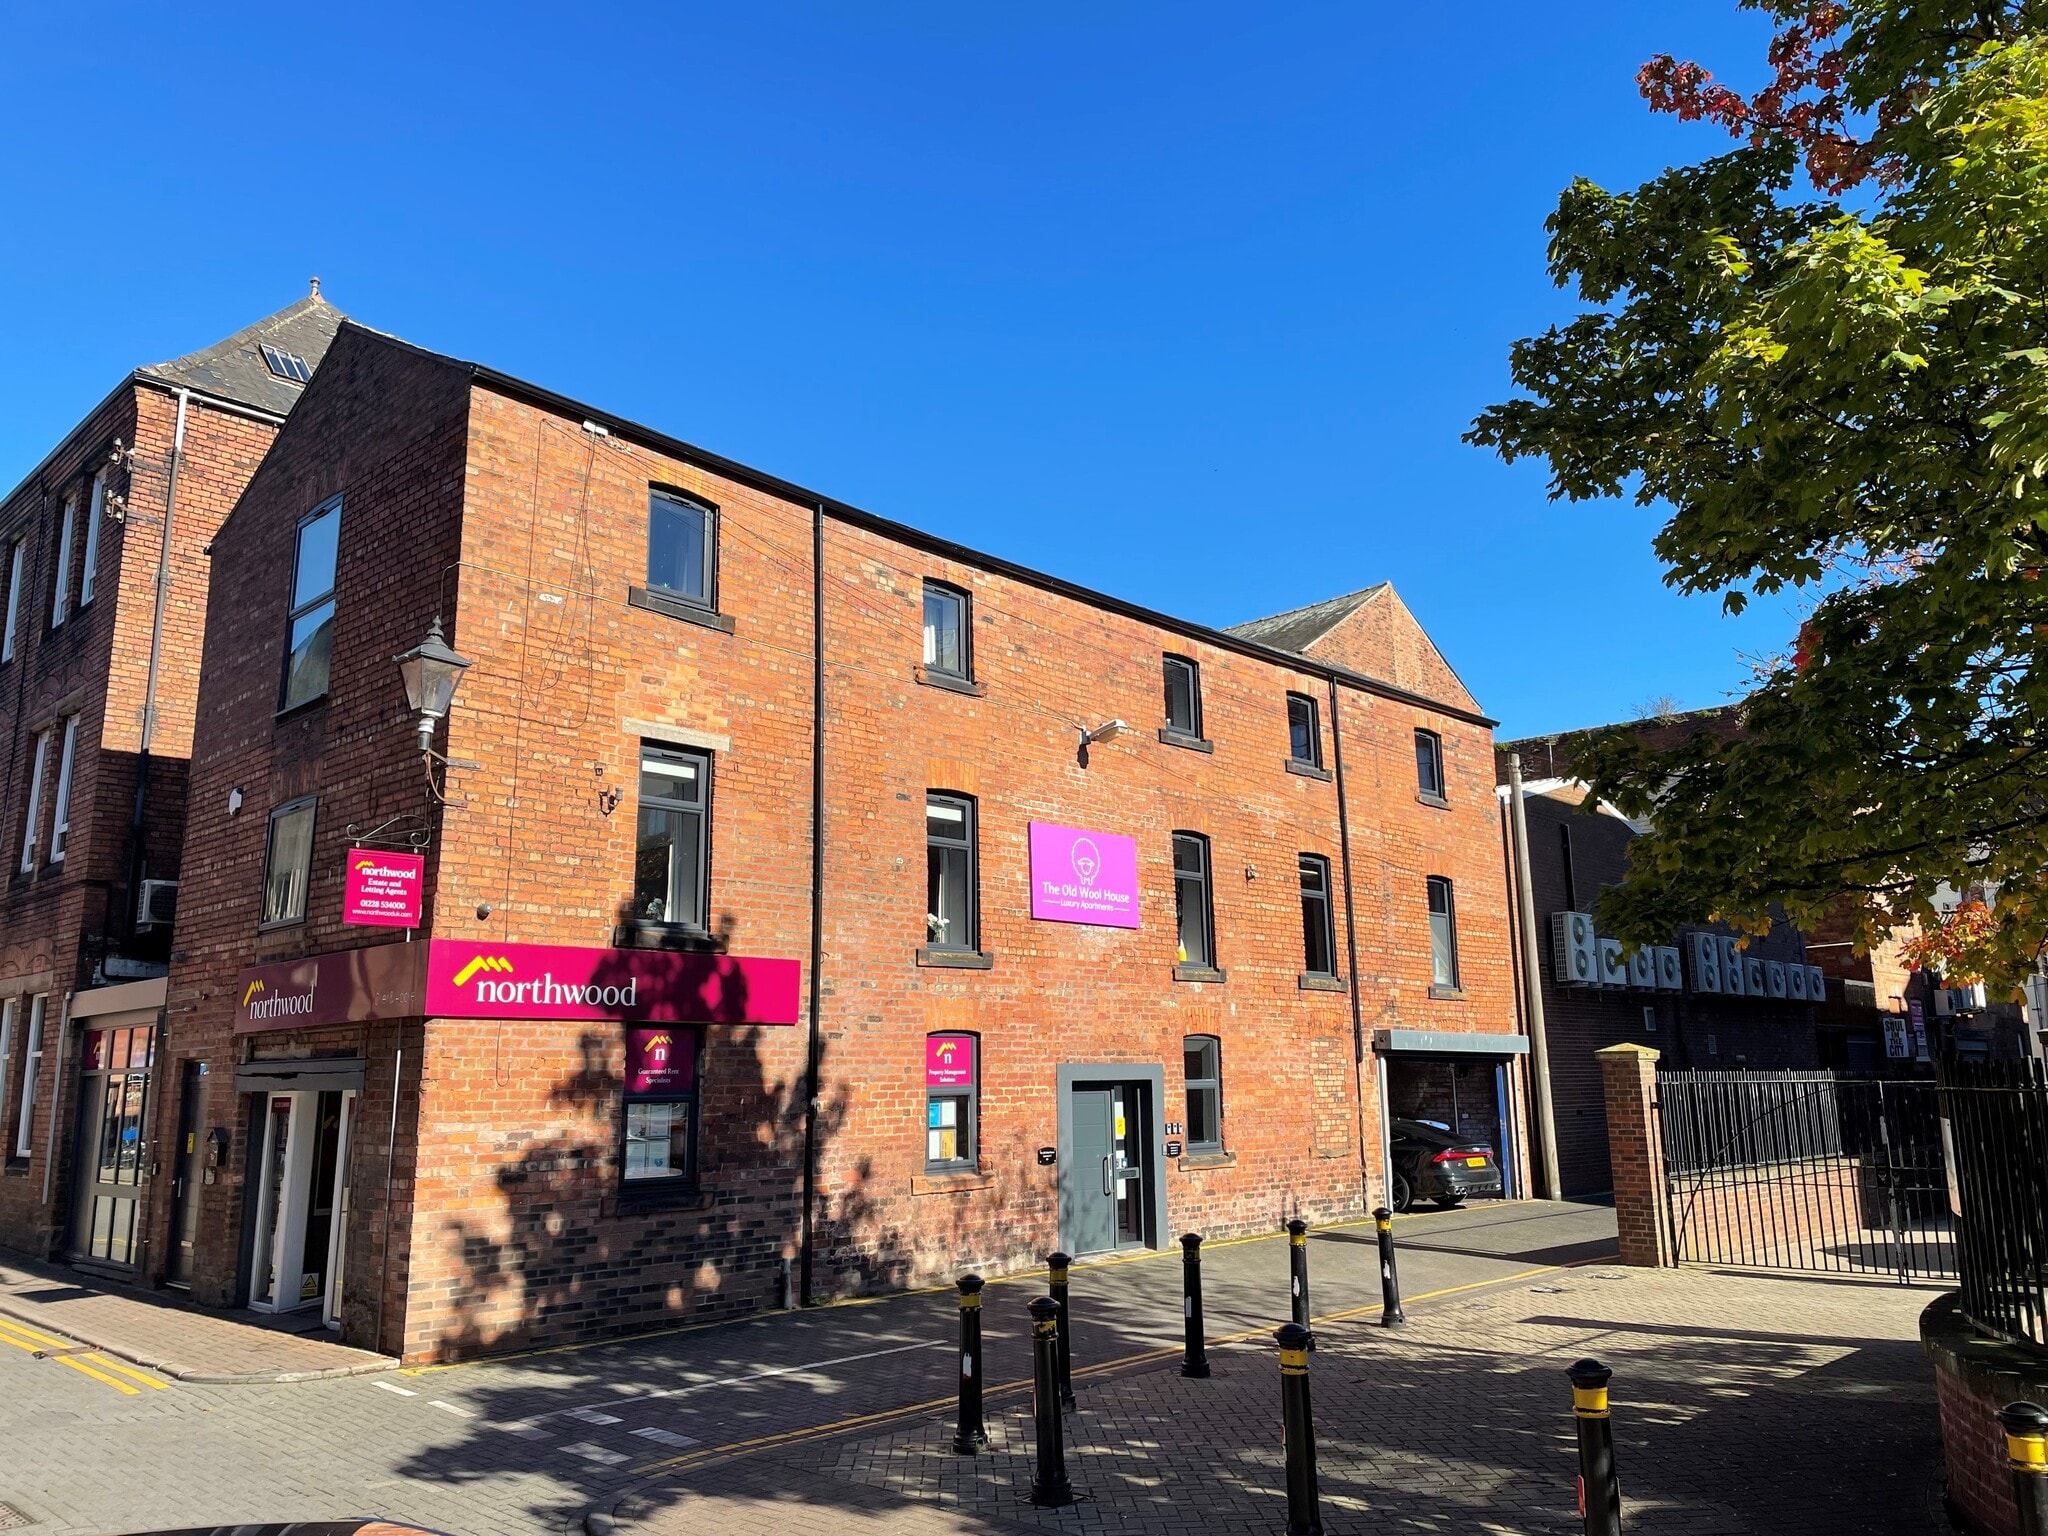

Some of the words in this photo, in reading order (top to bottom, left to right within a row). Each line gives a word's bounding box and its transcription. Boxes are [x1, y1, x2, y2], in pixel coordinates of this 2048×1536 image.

[362, 866, 416, 879] northwood
[368, 878, 388, 886] Estate
[361, 886, 384, 895] Letting
[385, 887, 407, 895] Agents
[1043, 882, 1060, 895] The
[1061, 884, 1078, 897] Old
[1080, 886, 1102, 900] Wool
[1104, 890, 1130, 903] House
[360, 899, 379, 907] 01228
[380, 901, 406, 909] 534000
[1060, 899, 1080, 908] Luxury
[1081, 900, 1115, 912] Apartments
[352, 909, 413, 917] www.northwooduk.com
[476, 974, 637, 1007] northwood
[249, 985, 314, 1020] northwood
[1885, 1021, 1904, 1032] SOUL
[654, 1048, 666, 1061] n
[1889, 1045, 1904, 1057] CITY
[944, 1053, 952, 1064] n
